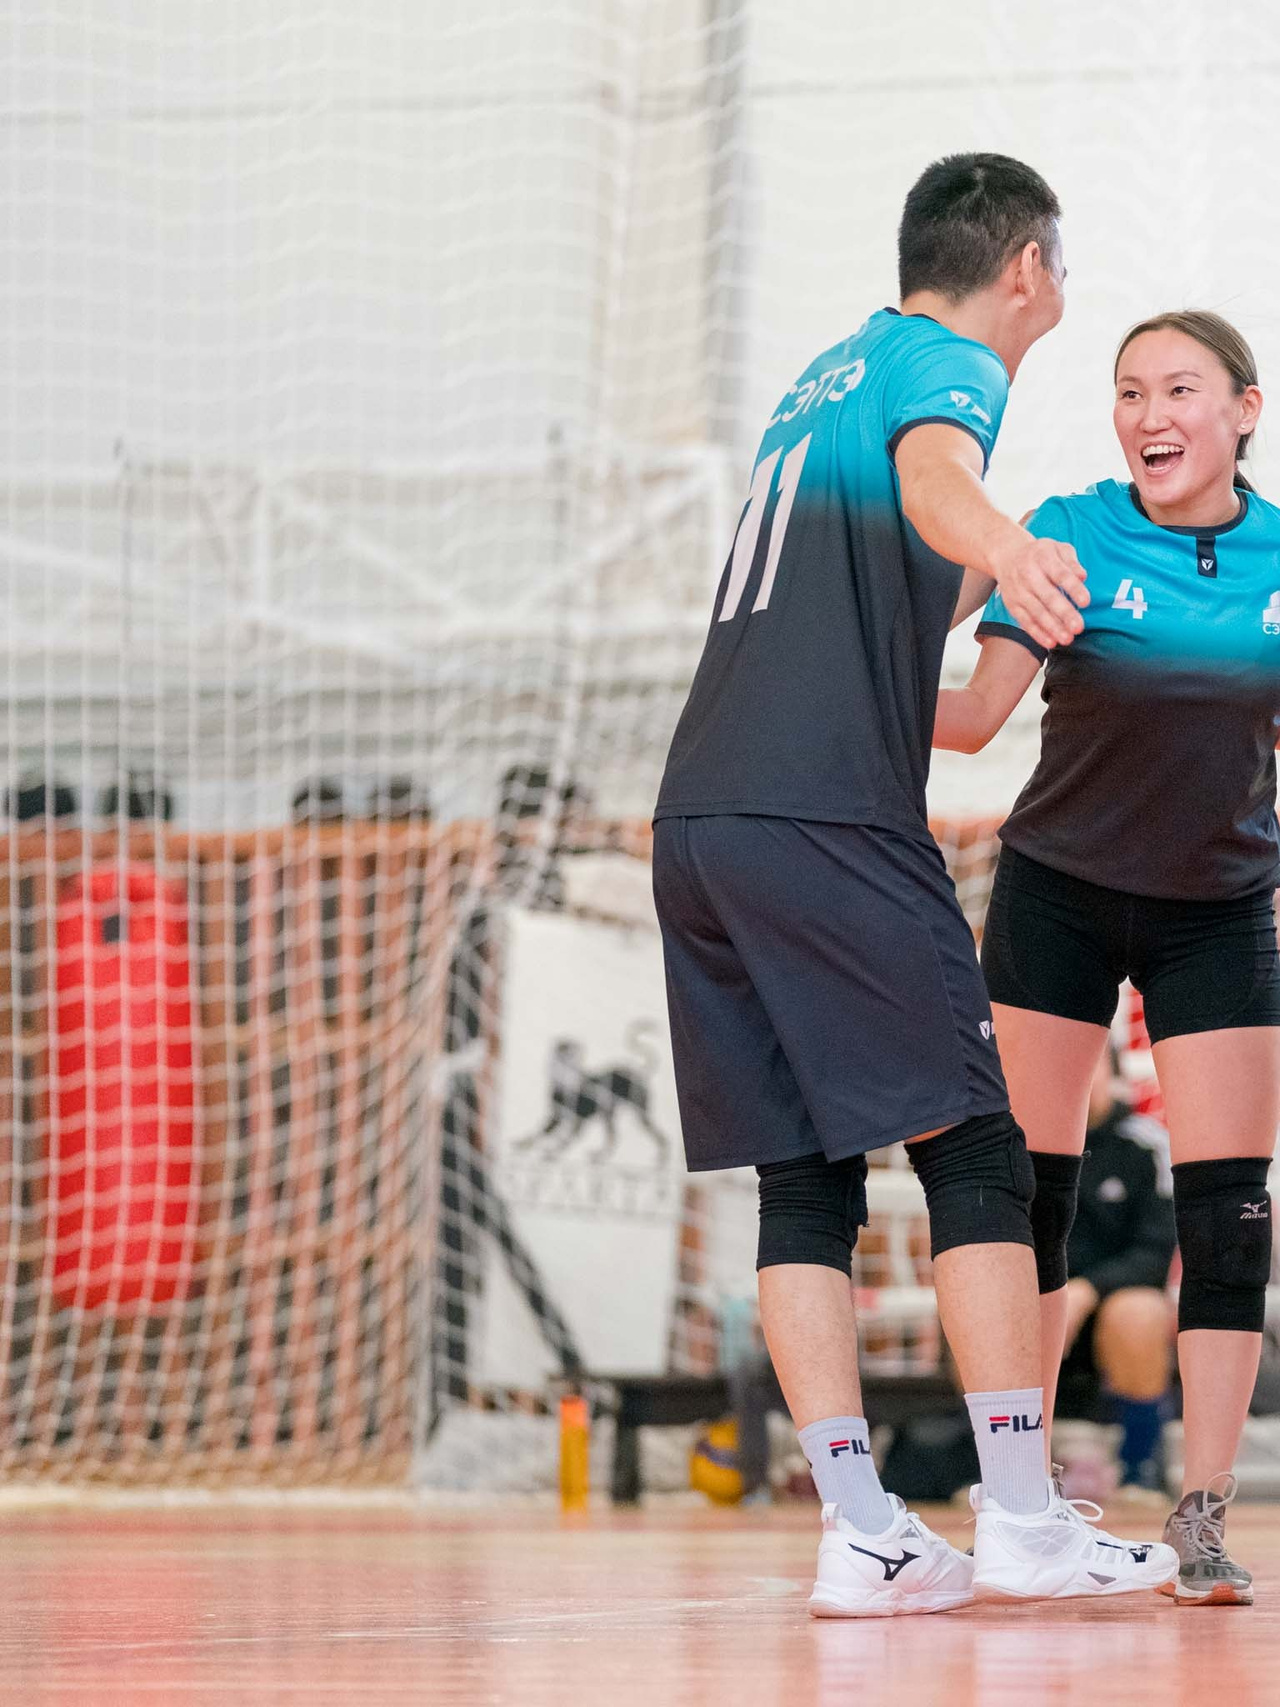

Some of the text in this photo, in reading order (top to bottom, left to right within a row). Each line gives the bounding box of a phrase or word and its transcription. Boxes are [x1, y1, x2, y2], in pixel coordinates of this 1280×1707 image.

[766, 358, 866, 430] СЭТТЭ
[717, 431, 813, 623] 11
[1111, 578, 1148, 620] 4
[829, 1439, 870, 1458] FIL
